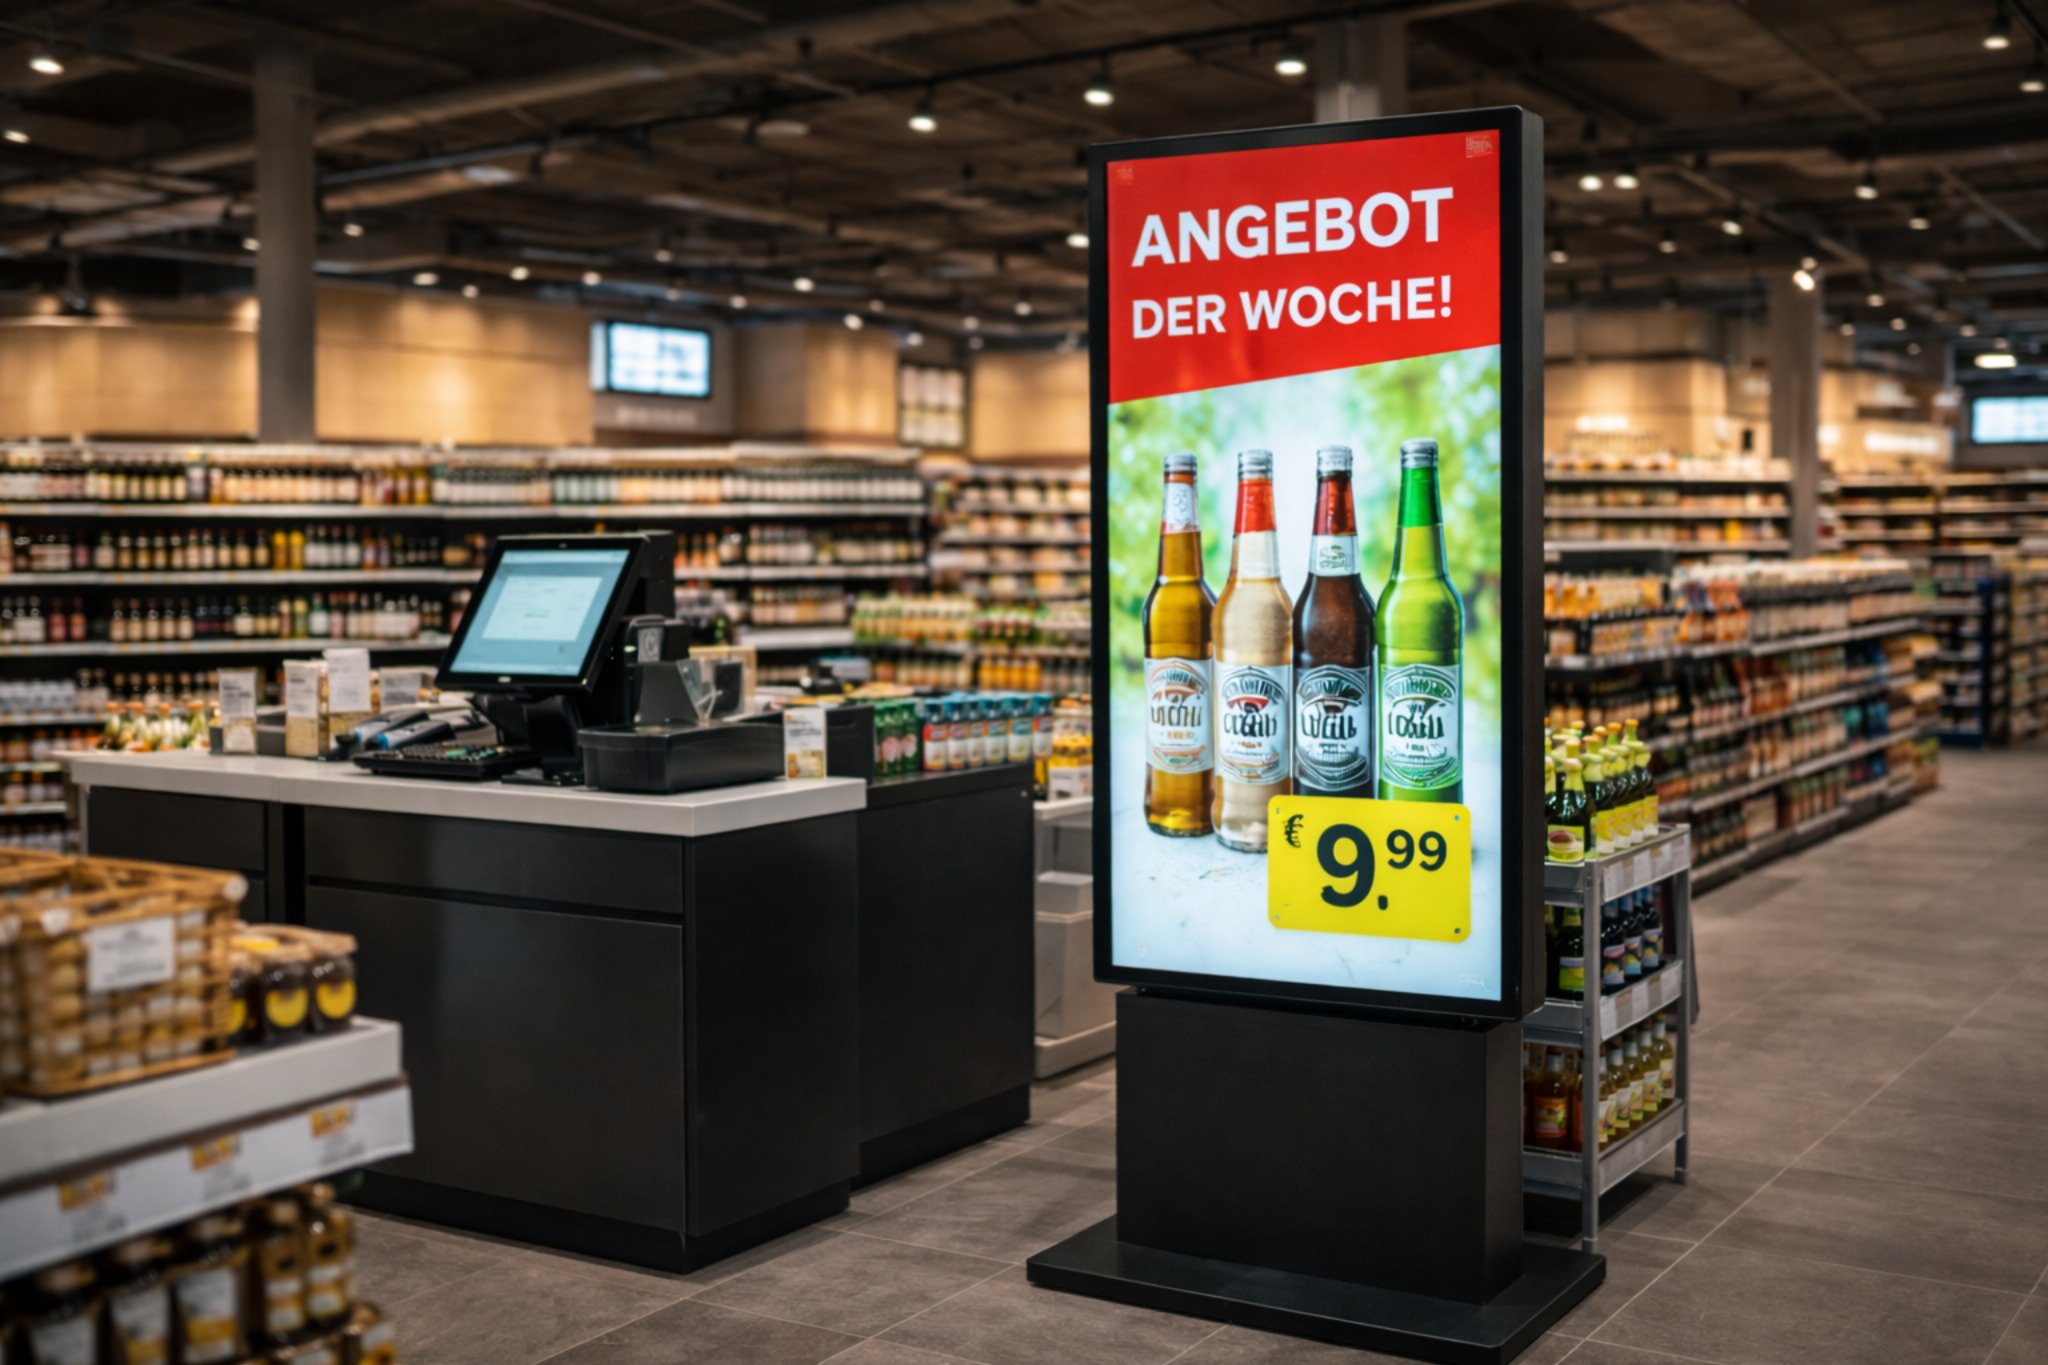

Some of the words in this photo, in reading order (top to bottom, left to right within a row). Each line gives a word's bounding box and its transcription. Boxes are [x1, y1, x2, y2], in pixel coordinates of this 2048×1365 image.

[1131, 186, 1454, 268] ANGEBOT
[1132, 294, 1227, 339] DER
[1239, 274, 1452, 331] WOCHE!
[1284, 813, 1304, 848] €
